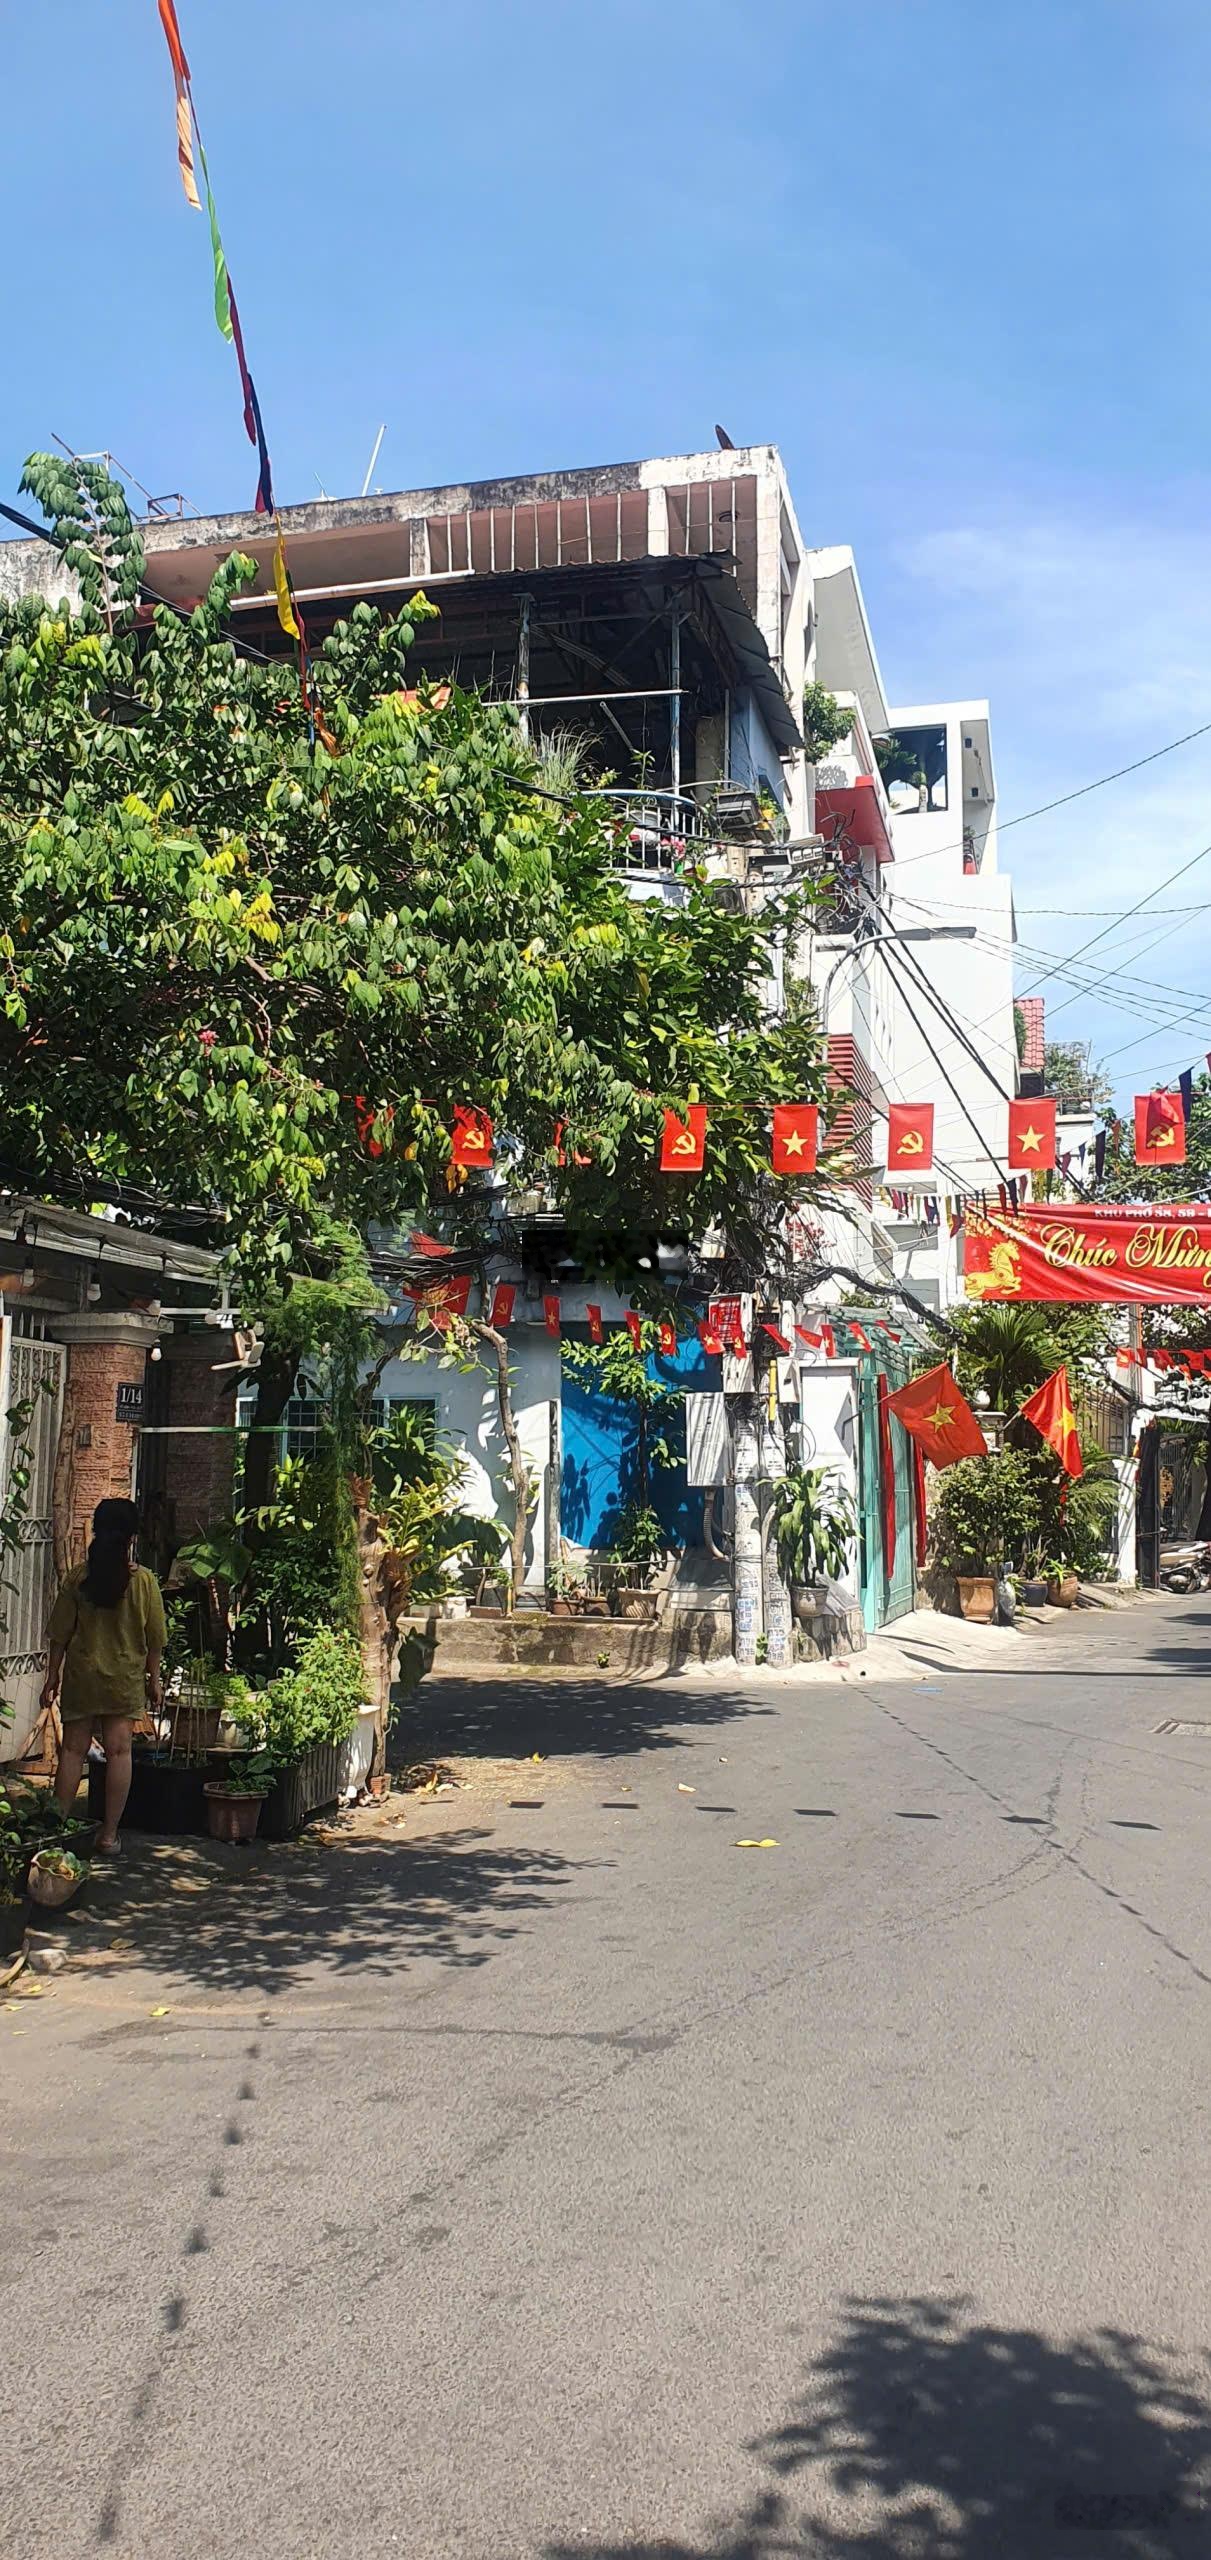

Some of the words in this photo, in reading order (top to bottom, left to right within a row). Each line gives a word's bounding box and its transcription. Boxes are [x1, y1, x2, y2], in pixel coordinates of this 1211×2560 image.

[1095, 1209, 1122, 1217] KHU
[1125, 1207, 1153, 1217] PHỐ
[1040, 1223, 1118, 1268] Chúc
[1125, 1223, 1211, 1288] Mừn
[120, 1387, 143, 1404] 1/14
